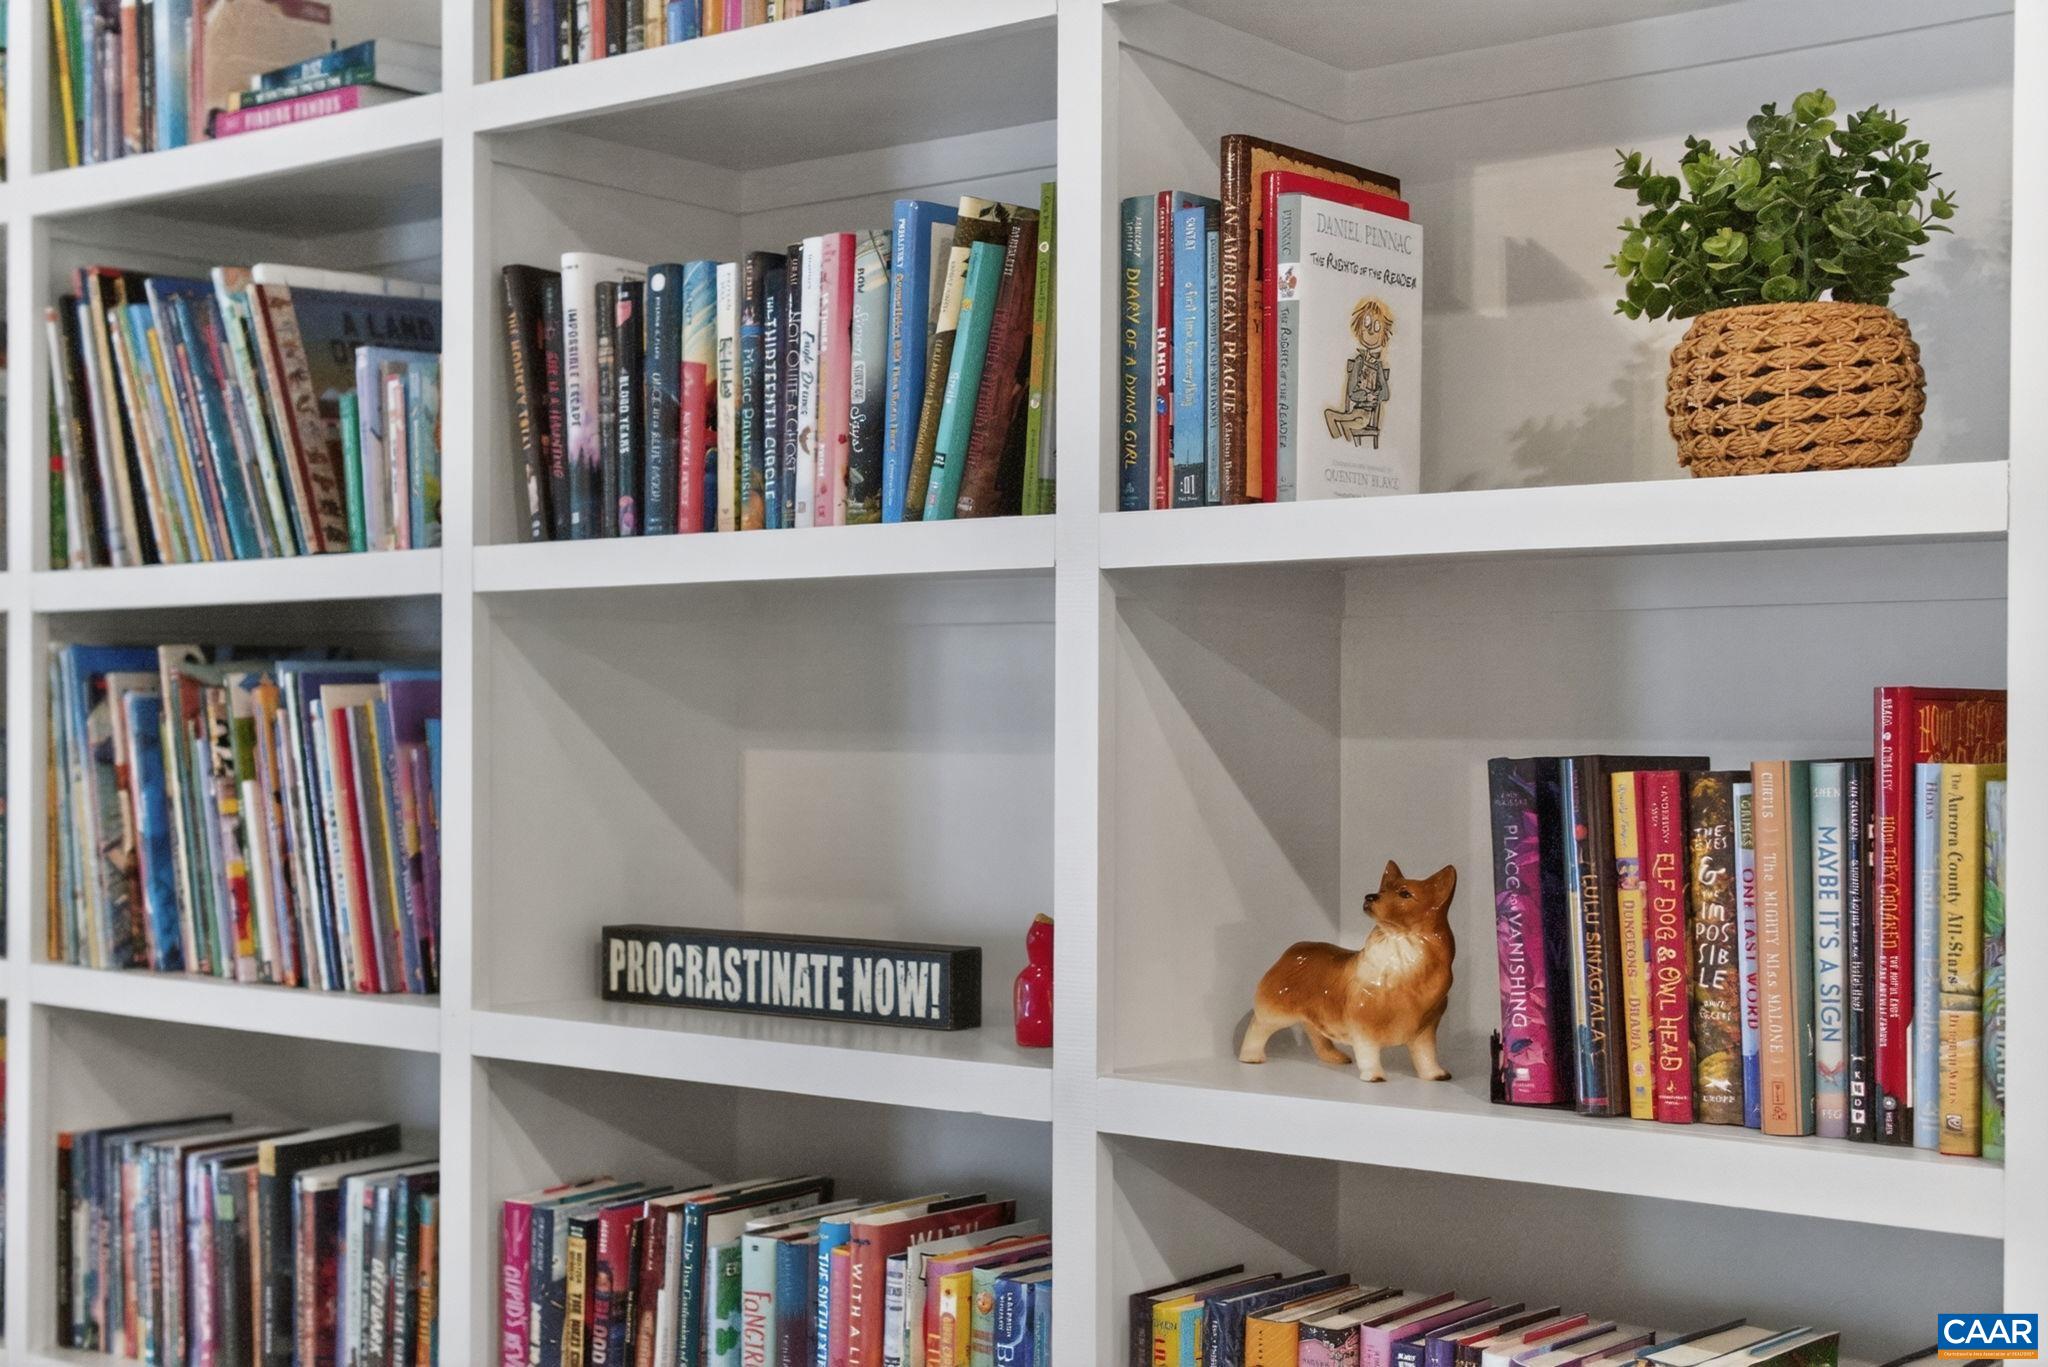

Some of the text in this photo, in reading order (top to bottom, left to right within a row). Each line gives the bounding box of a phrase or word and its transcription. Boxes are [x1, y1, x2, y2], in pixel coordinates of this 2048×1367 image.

[1316, 212, 1412, 255] DANIEL PENNAC
[1222, 200, 1238, 413] AN AMERICAN PLAGUE
[567, 309, 583, 427] IMPOSSIBLE ESCAPE
[764, 318, 777, 429] THIRTEENTH
[1124, 267, 1141, 470] DIARY OF A DYING GIRL
[1156, 327, 1167, 387] HANDS
[618, 375, 631, 454] BLOOD YEARS
[785, 311, 800, 472] NOT QUITE A GHOST
[765, 437, 776, 500] CIRCLE
[1918, 704, 1954, 753] HOW
[1503, 825, 1520, 889] PLACE
[1879, 816, 1896, 845] HOW
[1653, 853, 1676, 891] ELF
[1879, 847, 1898, 879] THEY
[1944, 773, 1965, 984] The Aurora County All-Stars
[1654, 896, 1677, 940] DOG
[1695, 922, 1730, 943] POS
[1740, 799, 1759, 1030] GRIMES ONE LAST WORD
[1760, 773, 1782, 1053] CURTIS The MIGHTY MALONE
[1818, 825, 1841, 1043] MAYBE IT'S A SIGN
[608, 937, 941, 1020] PROCRASTINATE NOW!
[1508, 913, 1528, 1028] VANISHING
[1581, 874, 1606, 1042] LULU SINAGTALA
[1623, 899, 1643, 1052] DUNGEONS DRAMA
[1656, 946, 1676, 963] &
[1698, 943, 1729, 965] SIB
[1698, 968, 1728, 989] LE
[1655, 966, 1682, 1011] OWL
[1658, 1015, 1683, 1071] HEAD
[504, 1265, 526, 1328] CUPID'S
[818, 1253, 829, 1330] THE SIXTH
[851, 1263, 863, 1317] WITH
[850, 1325, 861, 1337] A
